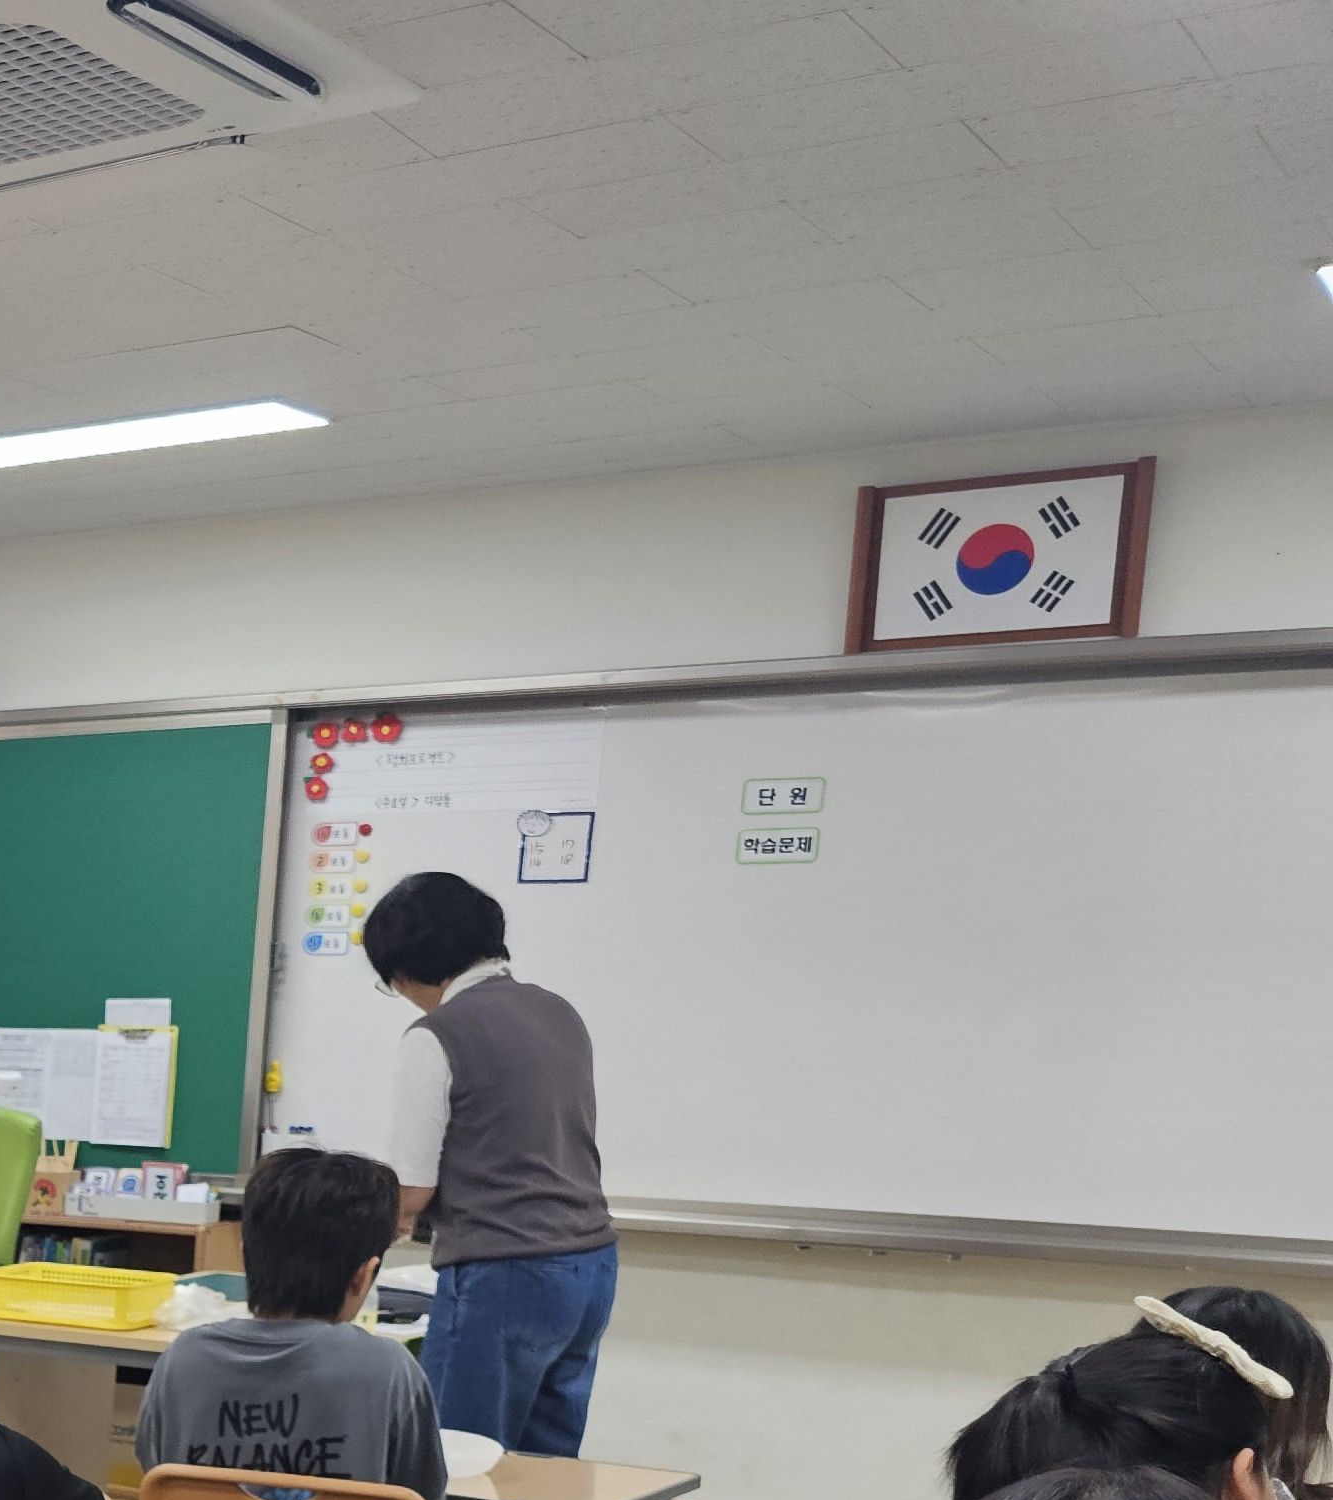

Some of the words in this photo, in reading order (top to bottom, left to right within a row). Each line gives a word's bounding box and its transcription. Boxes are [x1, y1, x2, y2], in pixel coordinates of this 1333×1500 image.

[758, 787, 776, 806] 단
[789, 786, 807, 805] 원
[743, 836, 813, 855] 학습문제
[217, 1392, 300, 1439] NEW
